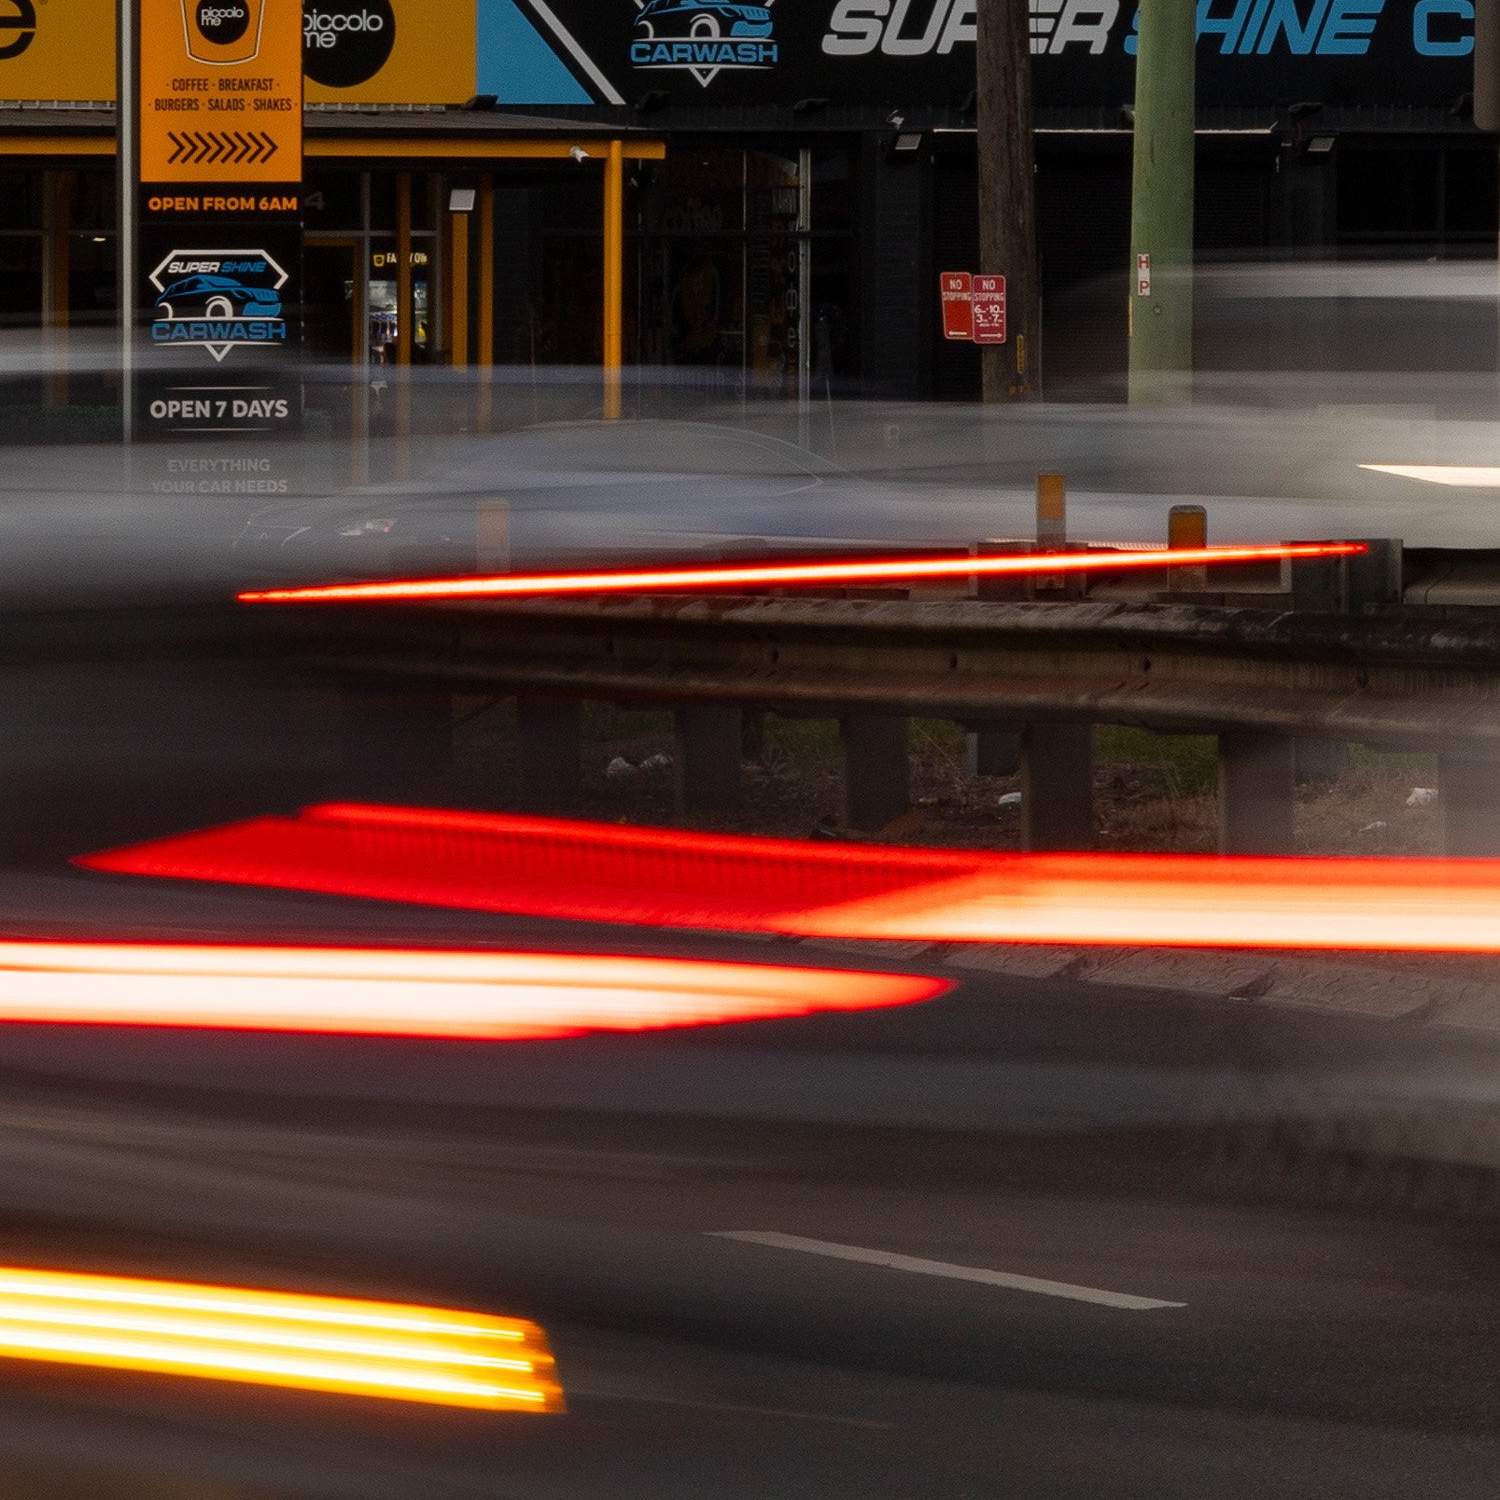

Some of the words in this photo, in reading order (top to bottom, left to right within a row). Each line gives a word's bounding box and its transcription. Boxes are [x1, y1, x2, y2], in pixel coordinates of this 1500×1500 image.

[200, 6, 245, 21] piccolo
[200, 17, 222, 27] me
[630, 42, 779, 64] CARWASH
[171, 78, 210, 92] COFFEE
[218, 78, 274, 92] BREAKFAST
[154, 98, 200, 112] BURGERS
[208, 98, 245, 112] SALADS
[253, 98, 292, 112] SHAKES
[148, 197, 199, 212] OPEN
[202, 197, 255, 212] FROM
[258, 197, 298, 212] 6AM
[167, 261, 221, 274] SUPER
[220, 260, 268, 274] SHINE
[948, 279, 963, 290] NO
[981, 280, 996, 290] NO
[151, 321, 287, 341] CARWASH
[150, 399, 212, 419] OPEN
[215, 400, 230, 418] 7
[232, 399, 289, 419] DAYS
[168, 458, 271, 473] EVERYTHING
[152, 480, 196, 495] YOUR
[199, 480, 231, 494] CAR
[233, 479, 288, 494] NEEDS
